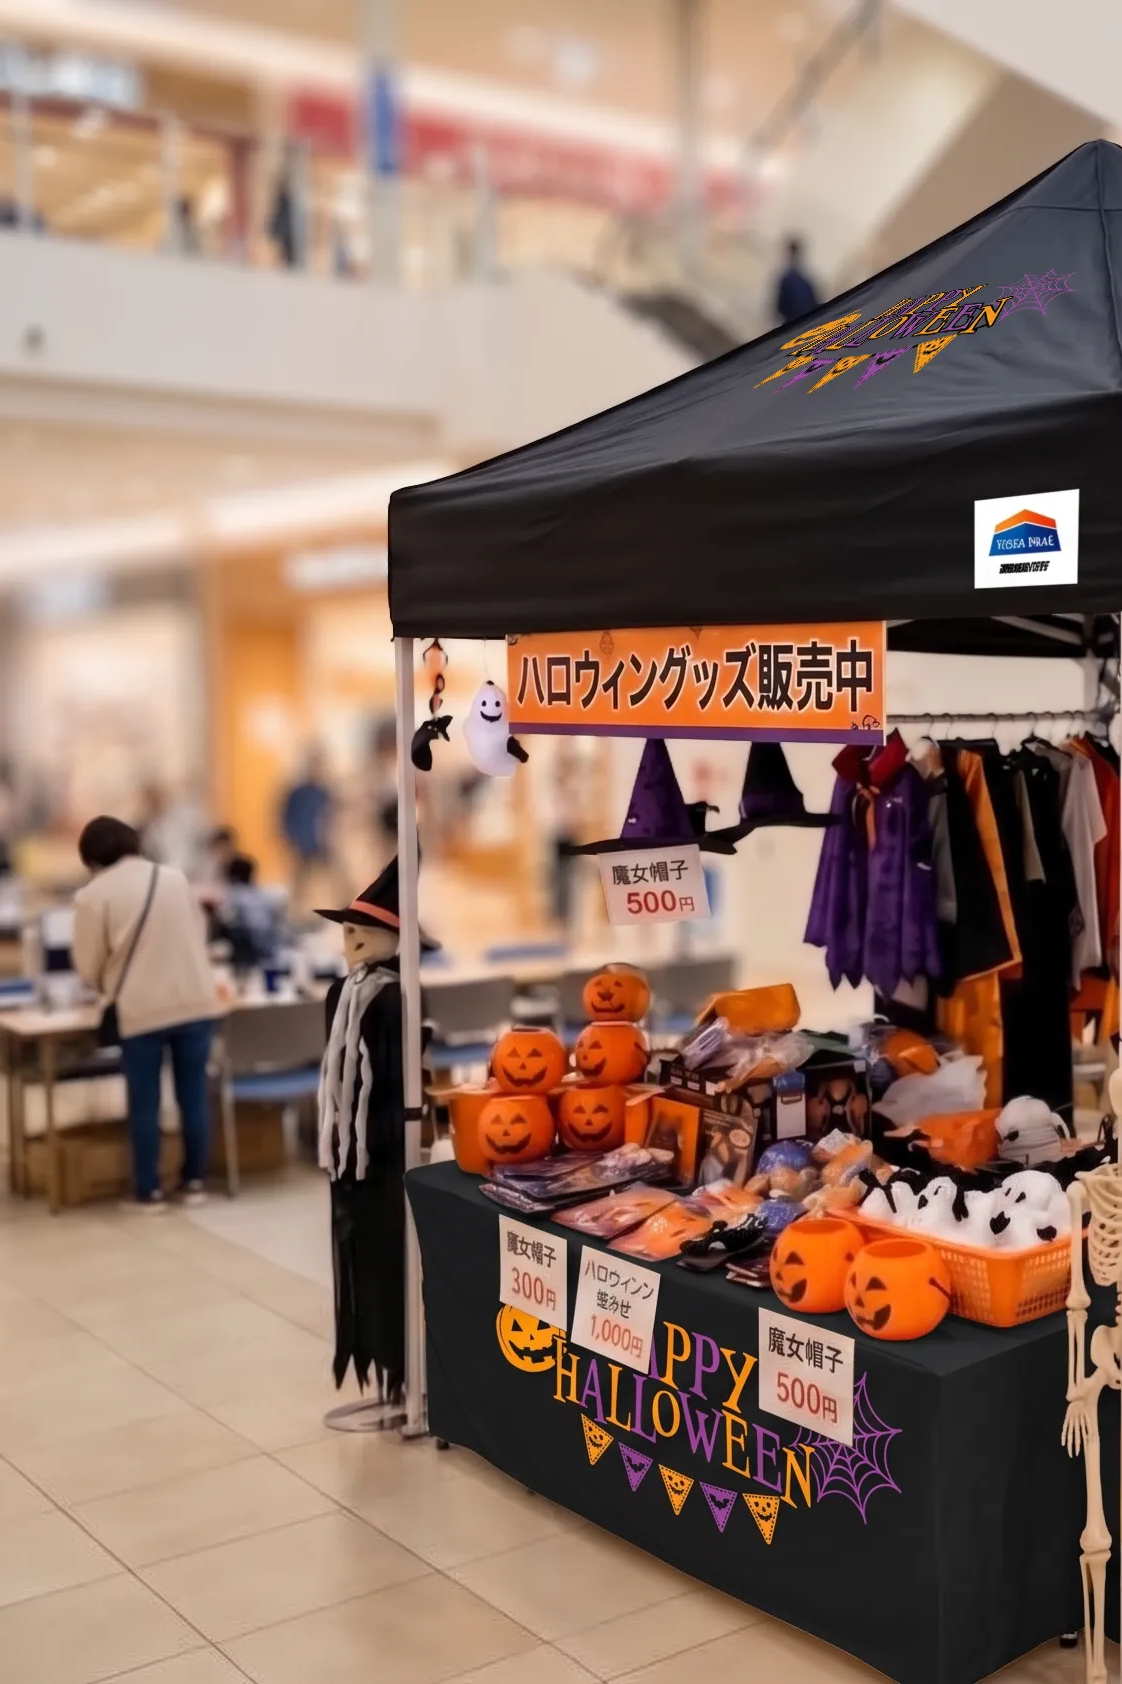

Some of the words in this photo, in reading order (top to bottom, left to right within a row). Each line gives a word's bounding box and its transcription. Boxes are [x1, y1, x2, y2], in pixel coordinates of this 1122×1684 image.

[517, 639, 873, 712] ハロウィングッズ販売中
[612, 859, 689, 885] 魔女帽子
[627, 890, 695, 914] 500円
[511, 1266, 556, 1311] 300円
[591, 1314, 644, 1359] 1,000円
[768, 1326, 844, 1373] 魔女帽子
[648, 1321, 758, 1413] PPY
[777, 1371, 838, 1424] 500円
[552, 1336, 816, 1509] HALLOWEEN
